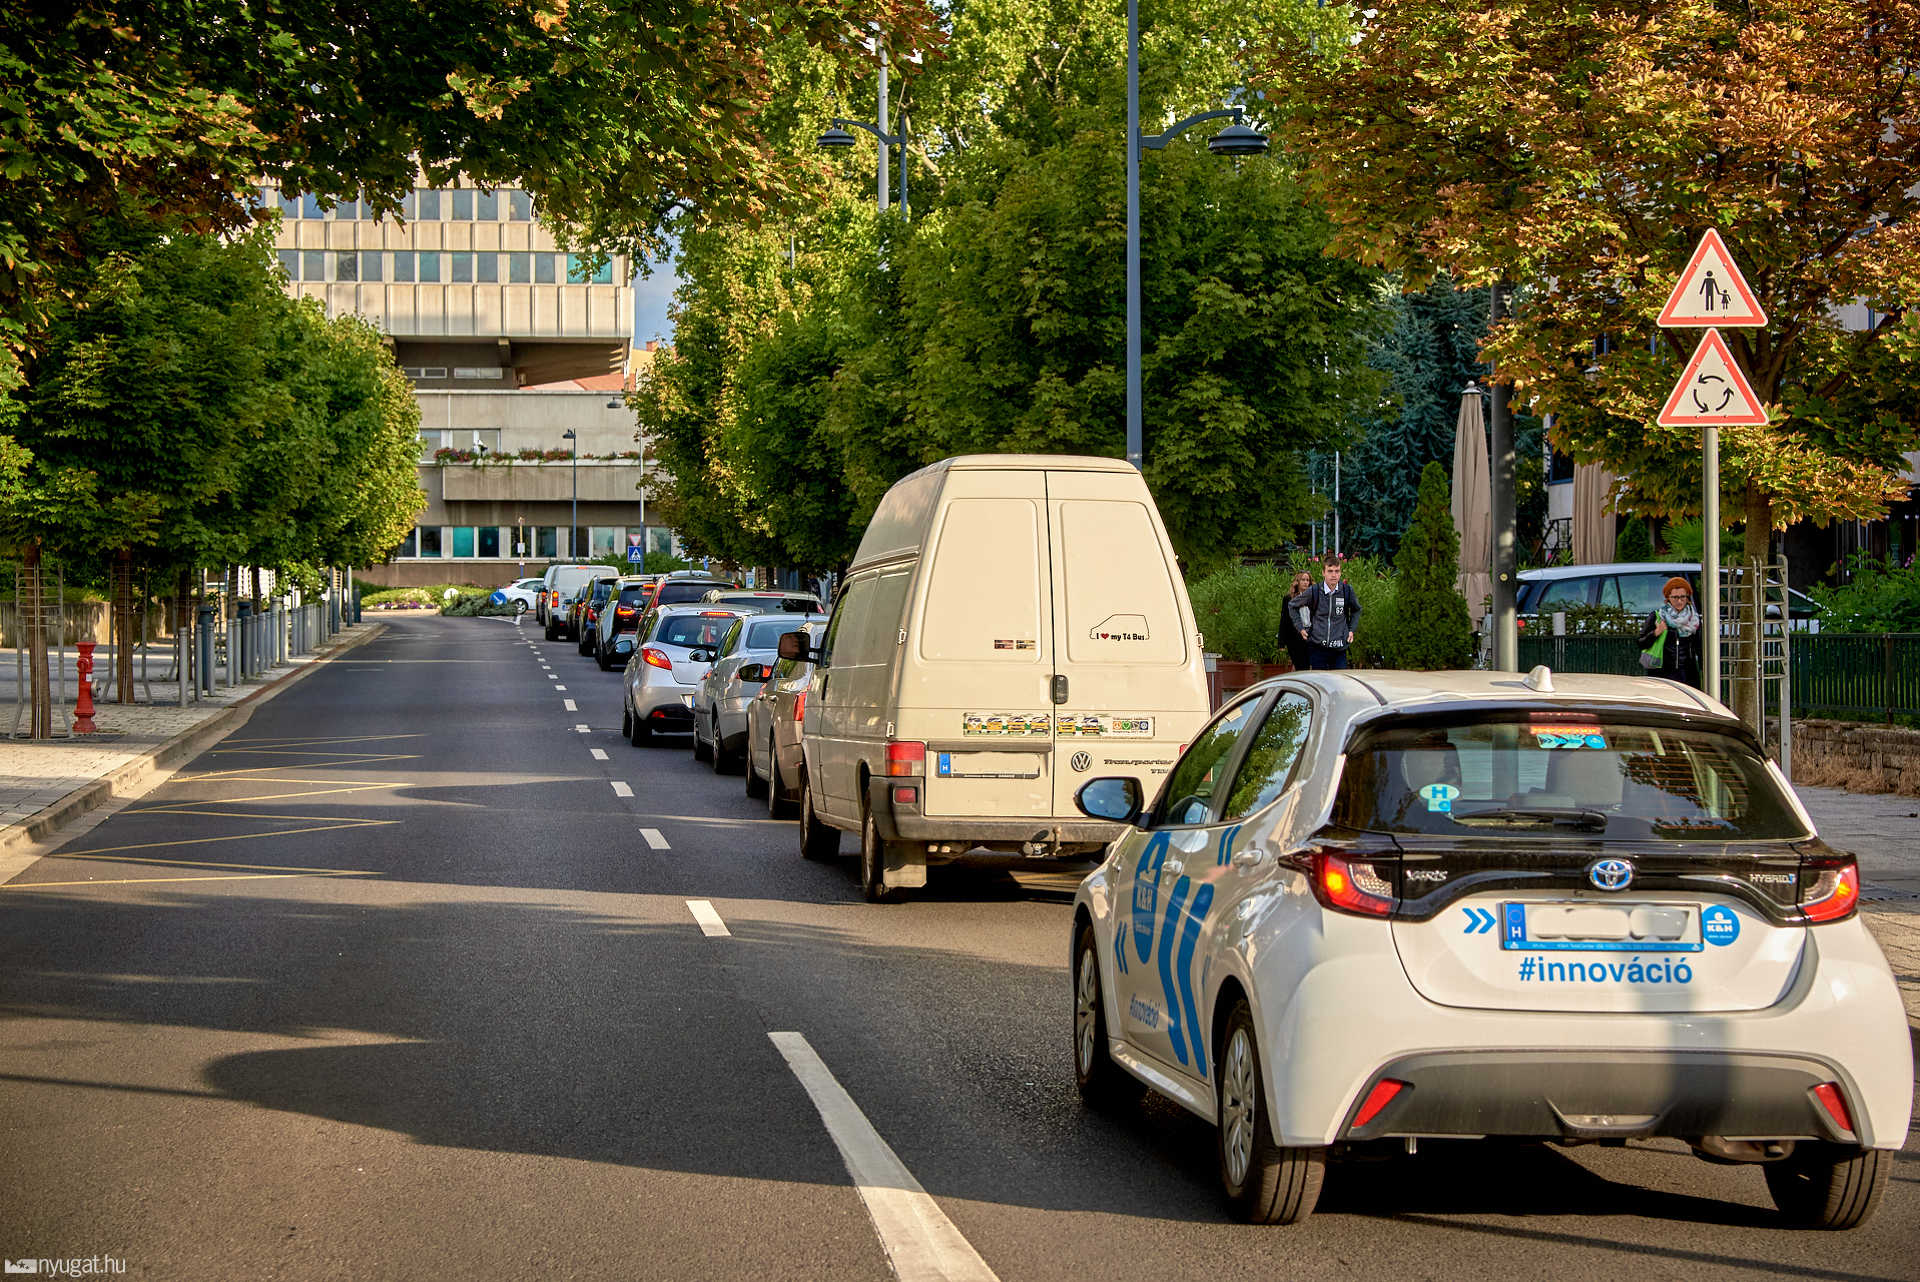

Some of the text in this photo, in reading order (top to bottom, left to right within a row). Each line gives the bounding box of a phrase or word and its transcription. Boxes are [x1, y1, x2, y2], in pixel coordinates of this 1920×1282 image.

[1110, 634, 1122, 642] my
[1132, 633, 1145, 641] Bus
[1431, 786, 1448, 799] H
[1749, 873, 1790, 884] HYBRID
[1511, 926, 1522, 938] H
[1706, 924, 1733, 932] K&H
[1518, 956, 1693, 984] #innováció
